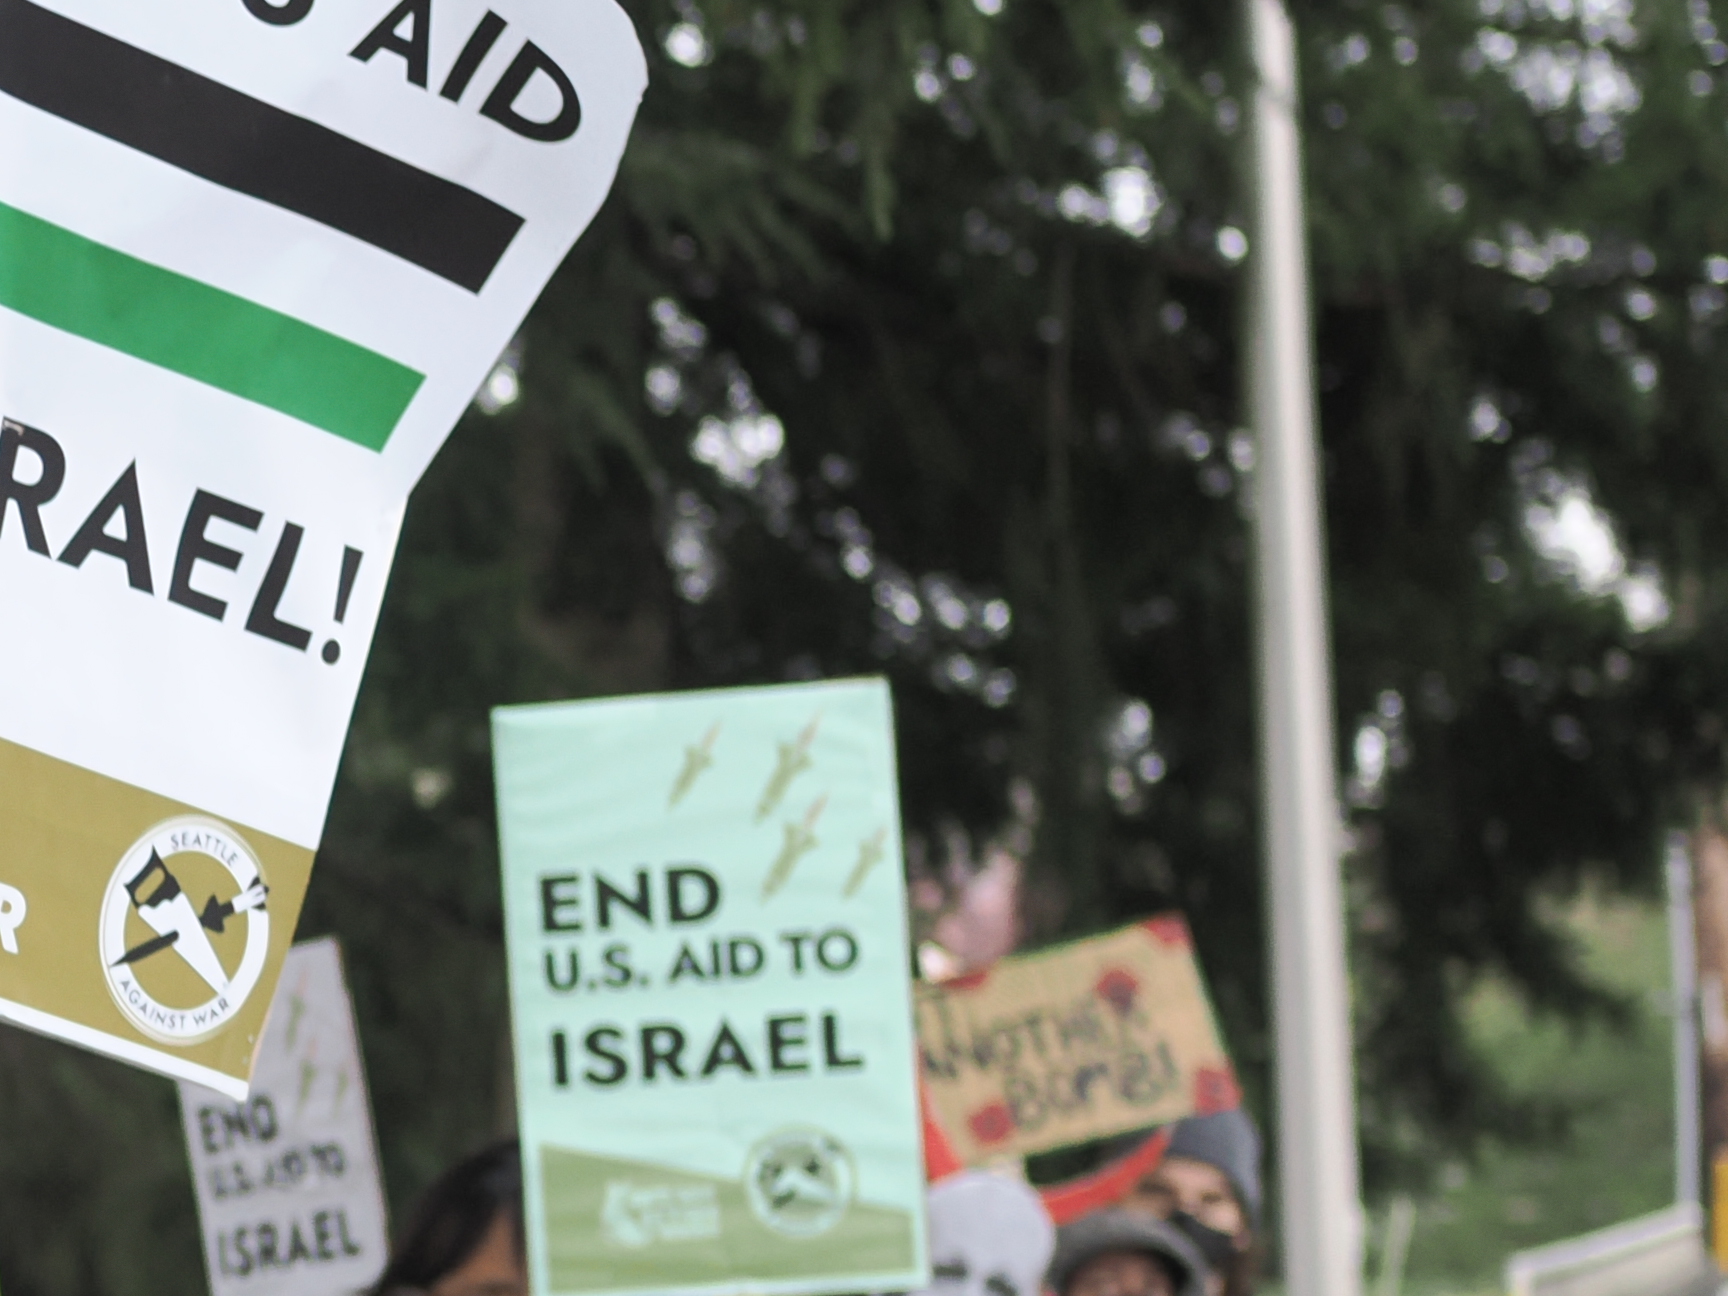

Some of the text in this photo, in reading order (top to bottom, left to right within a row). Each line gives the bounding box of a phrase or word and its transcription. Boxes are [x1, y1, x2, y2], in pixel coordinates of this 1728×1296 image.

[170, 831, 239, 868] SEATTLE
[539, 865, 722, 934] END
[544, 927, 859, 994] U.S. AID TO
[120, 979, 230, 1030] AGAINST WAR
[550, 1011, 865, 1090] ISRAEL
[198, 1094, 278, 1154] END
[215, 1209, 360, 1277] ISRAEL
